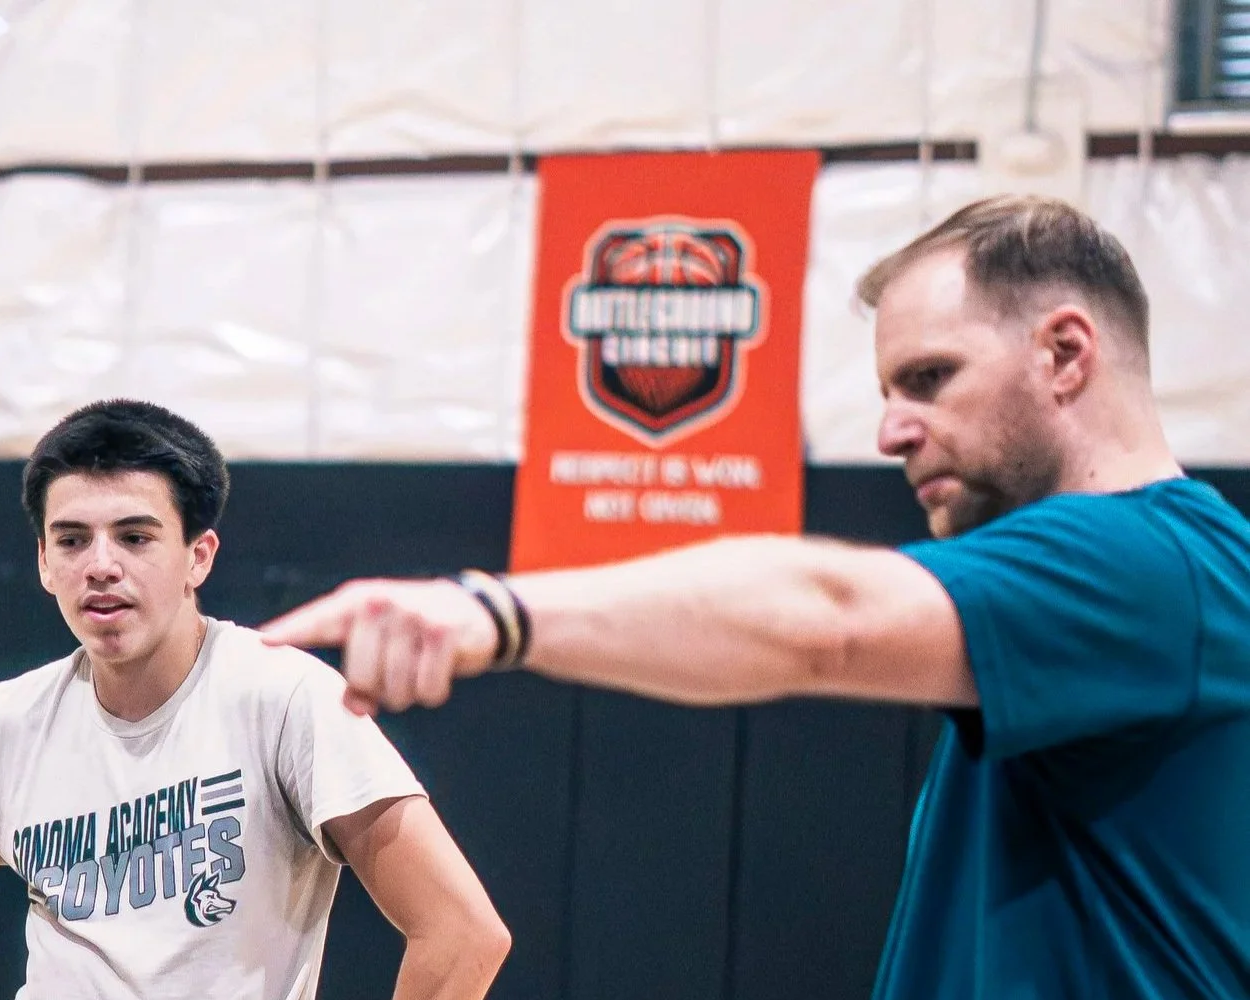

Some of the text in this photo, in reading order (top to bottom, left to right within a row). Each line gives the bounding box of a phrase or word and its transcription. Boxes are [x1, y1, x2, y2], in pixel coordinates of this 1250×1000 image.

[13, 776, 199, 882] SONOMA ACADEMY
[32, 816, 246, 922] COYOTES
